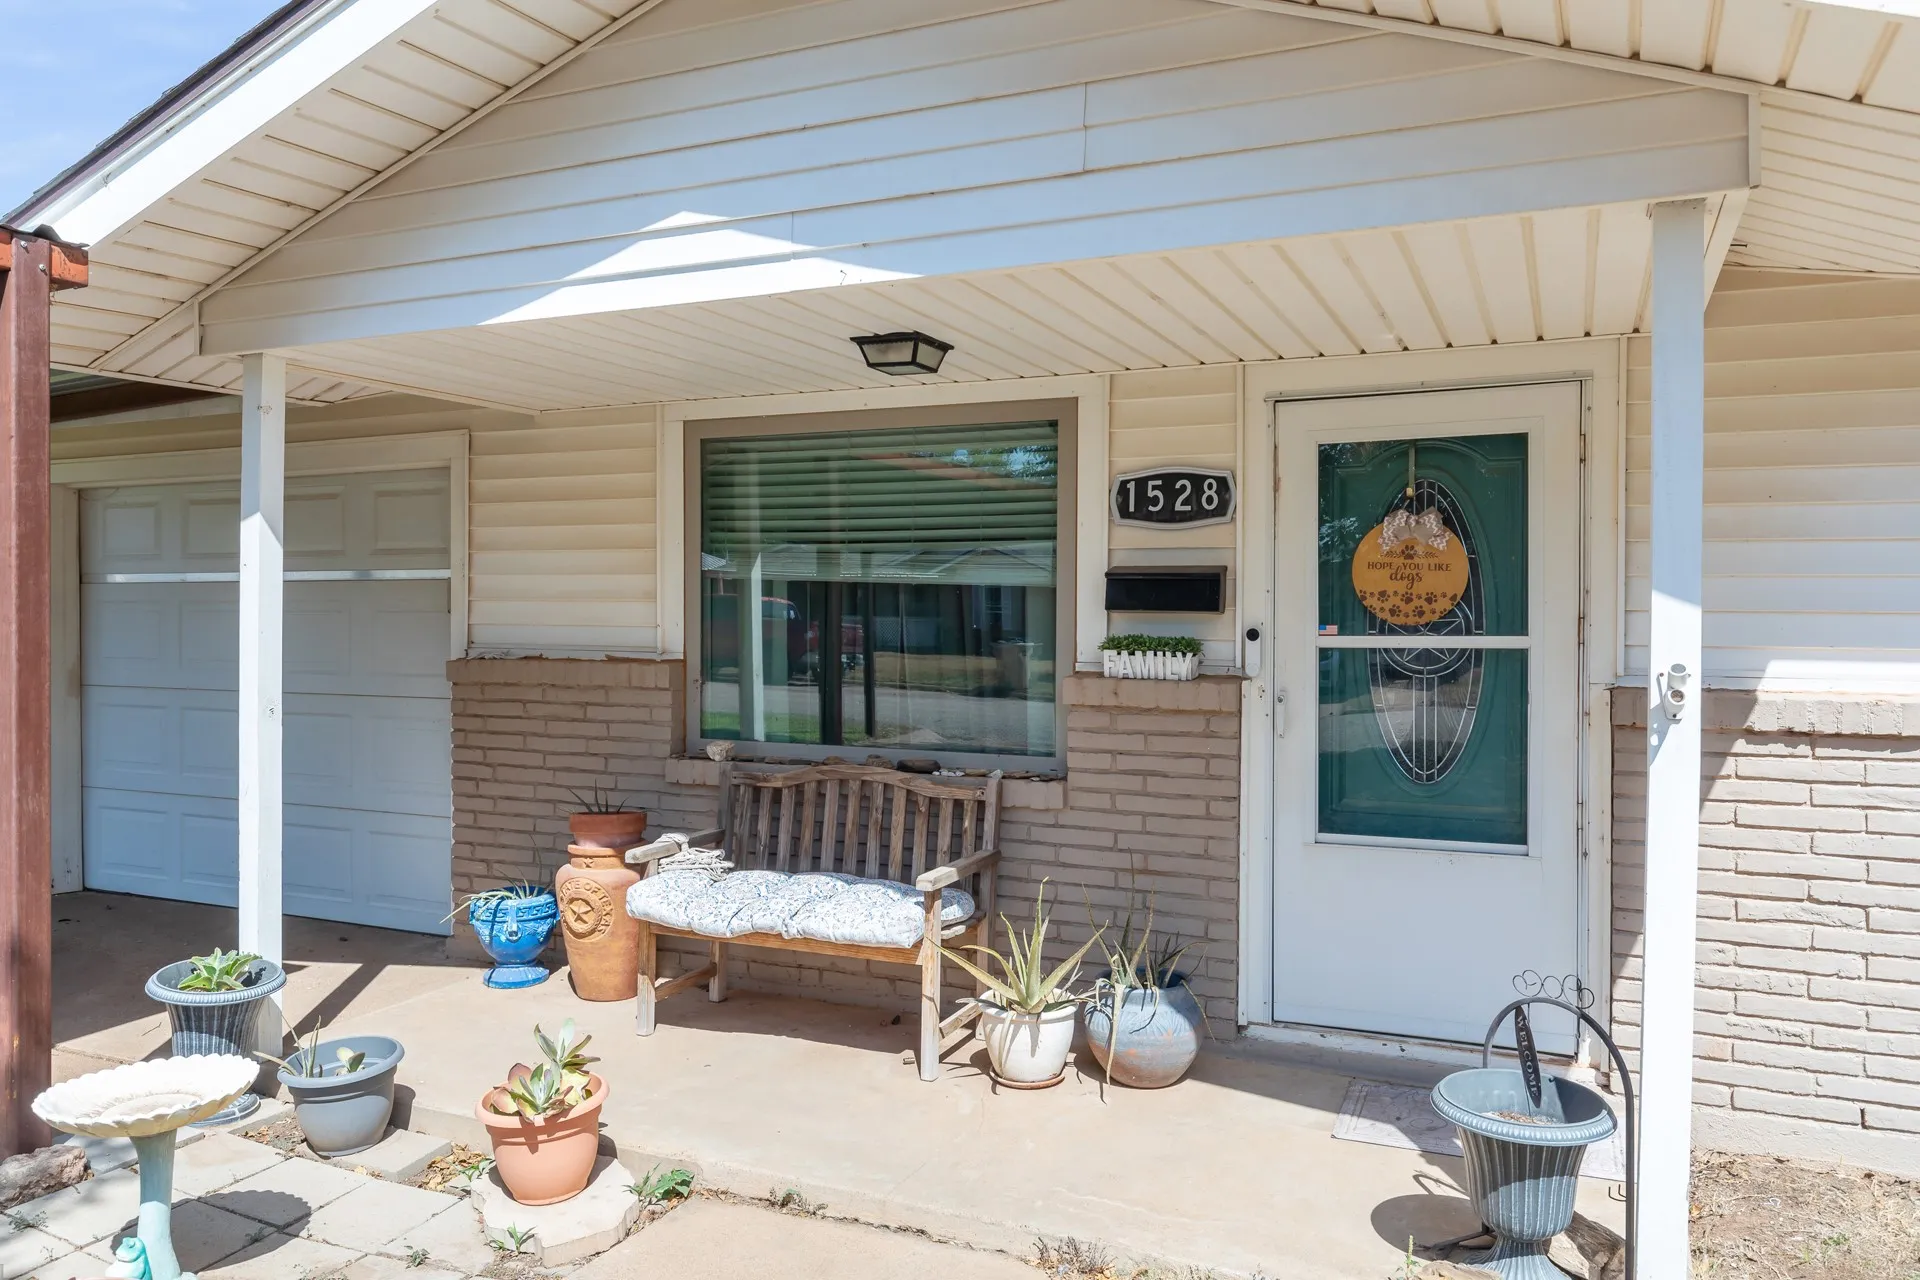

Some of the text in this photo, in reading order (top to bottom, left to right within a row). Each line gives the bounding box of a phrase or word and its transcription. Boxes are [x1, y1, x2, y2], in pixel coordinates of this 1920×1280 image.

[1126, 477, 1219, 513] 1528
[1367, 561, 1452, 572] HOPE YOU LIKE
[1389, 565, 1423, 590] dogs
[1103, 649, 1194, 681] FAMILY
[583, 882, 601, 895] OF
[1517, 1015, 1539, 1097] WELCOME
